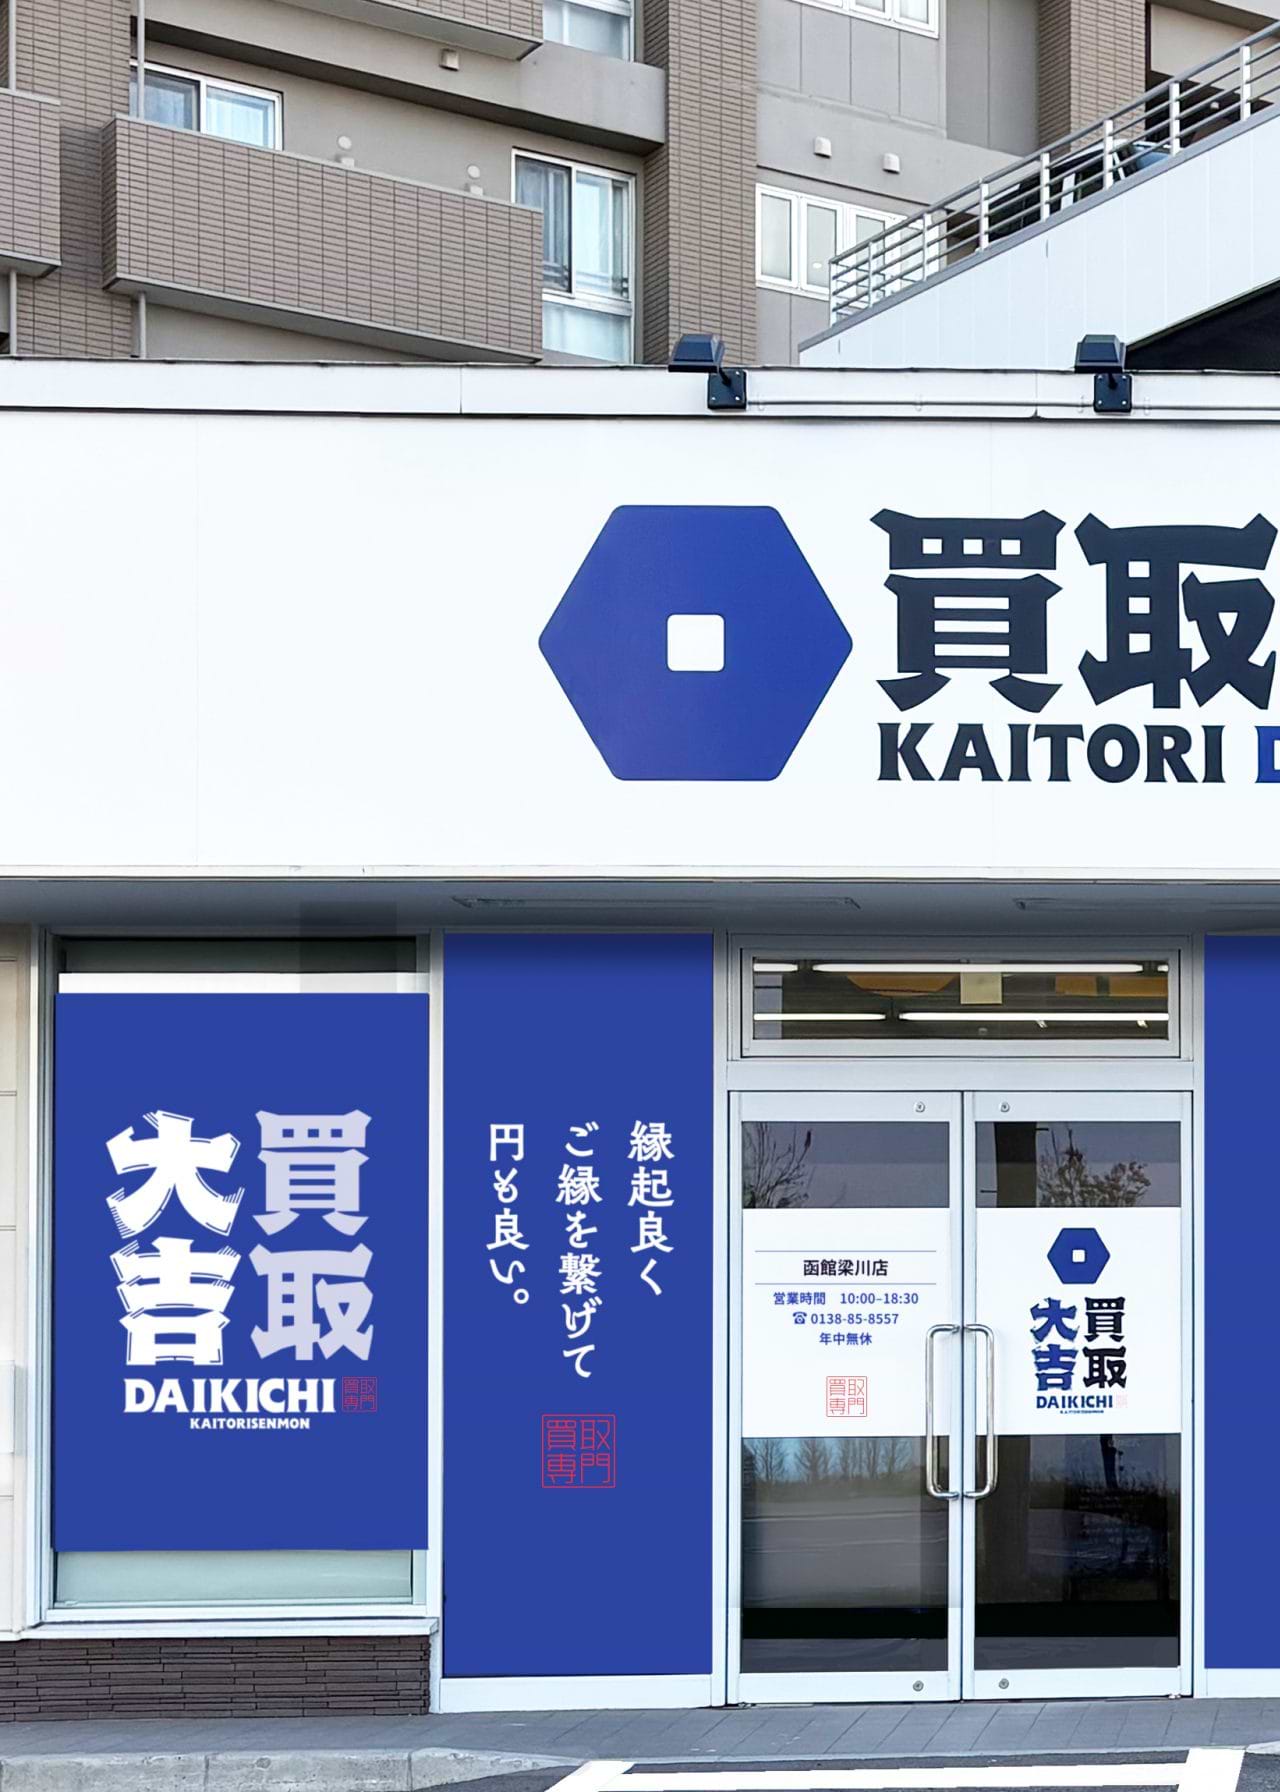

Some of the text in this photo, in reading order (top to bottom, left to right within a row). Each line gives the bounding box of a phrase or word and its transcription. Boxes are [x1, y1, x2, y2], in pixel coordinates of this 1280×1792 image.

[877, 722, 1226, 784] KAITORI
[105, 1110, 245, 1366] 大吉
[248, 1109, 374, 1361] 買取
[486, 1123, 530, 1305] 円も良い。
[627, 1120, 675, 1296] 縁起良く
[555, 1120, 603, 1378] ご縁を繋げて
[803, 1258, 889, 1277] 函館梁川店
[772, 1291, 827, 1306] 営業時間
[810, 1313, 900, 1325] 0138-85-8557
[819, 1332, 873, 1346] 年中無休
[1029, 1296, 1080, 1392] 大吉
[1081, 1296, 1128, 1389] 買取
[123, 1377, 337, 1414] DAIKICHI
[189, 1417, 311, 1430] KAITORISENMON
[1036, 1394, 1114, 1409] DAIKICHI
